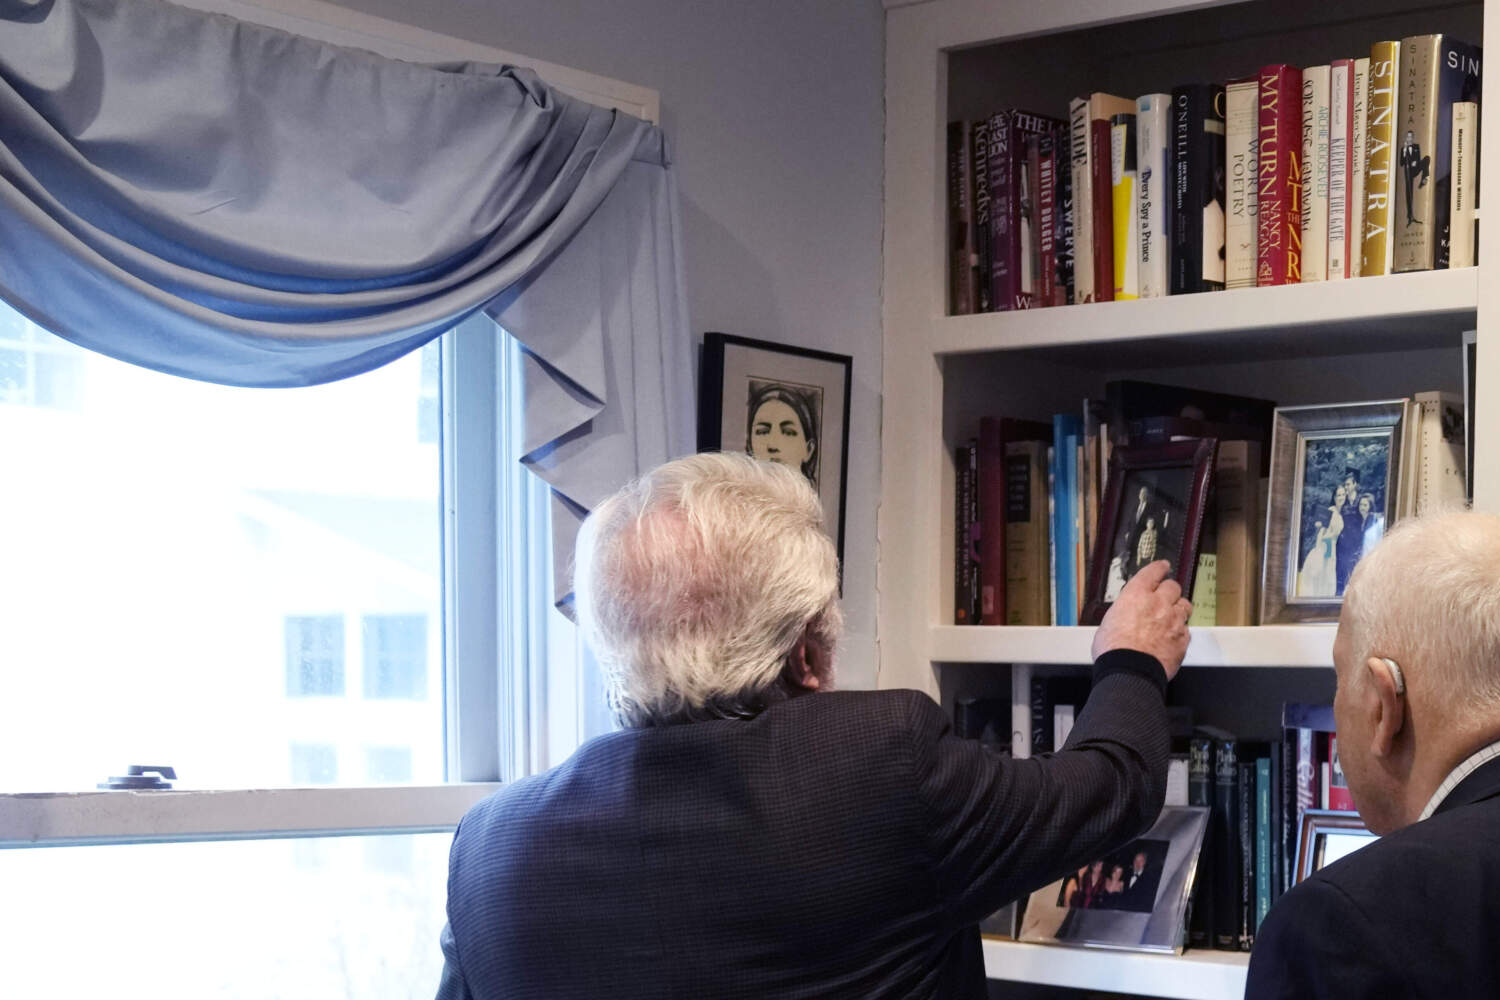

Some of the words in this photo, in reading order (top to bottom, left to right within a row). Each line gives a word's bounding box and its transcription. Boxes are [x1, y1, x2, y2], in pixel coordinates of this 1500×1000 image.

[1261, 73, 1279, 114] MY
[1407, 44, 1417, 124] SINATRA
[1178, 94, 1188, 156] O'NEILL
[1318, 106, 1329, 140] ARCHIE
[1260, 123, 1279, 196] TURN
[1317, 142, 1328, 198] ROOSEVELT
[1330, 138, 1346, 178] KEEPER
[1366, 60, 1392, 240] SINATRA
[974, 124, 991, 225] Kennedys
[1039, 159, 1052, 204] WHITEY
[1141, 168, 1152, 199] Every
[1232, 154, 1245, 218] POETRY
[1247, 139, 1258, 217] WORLD
[1330, 180, 1345, 194] OF
[1041, 207, 1052, 252] BULGER
[1142, 201, 1151, 221] Spy
[1260, 201, 1270, 258] REAGAN
[1269, 200, 1281, 250] NANCY
[1330, 196, 1345, 218] THE
[1142, 231, 1151, 263] Prince
[1329, 219, 1344, 242] GATE
